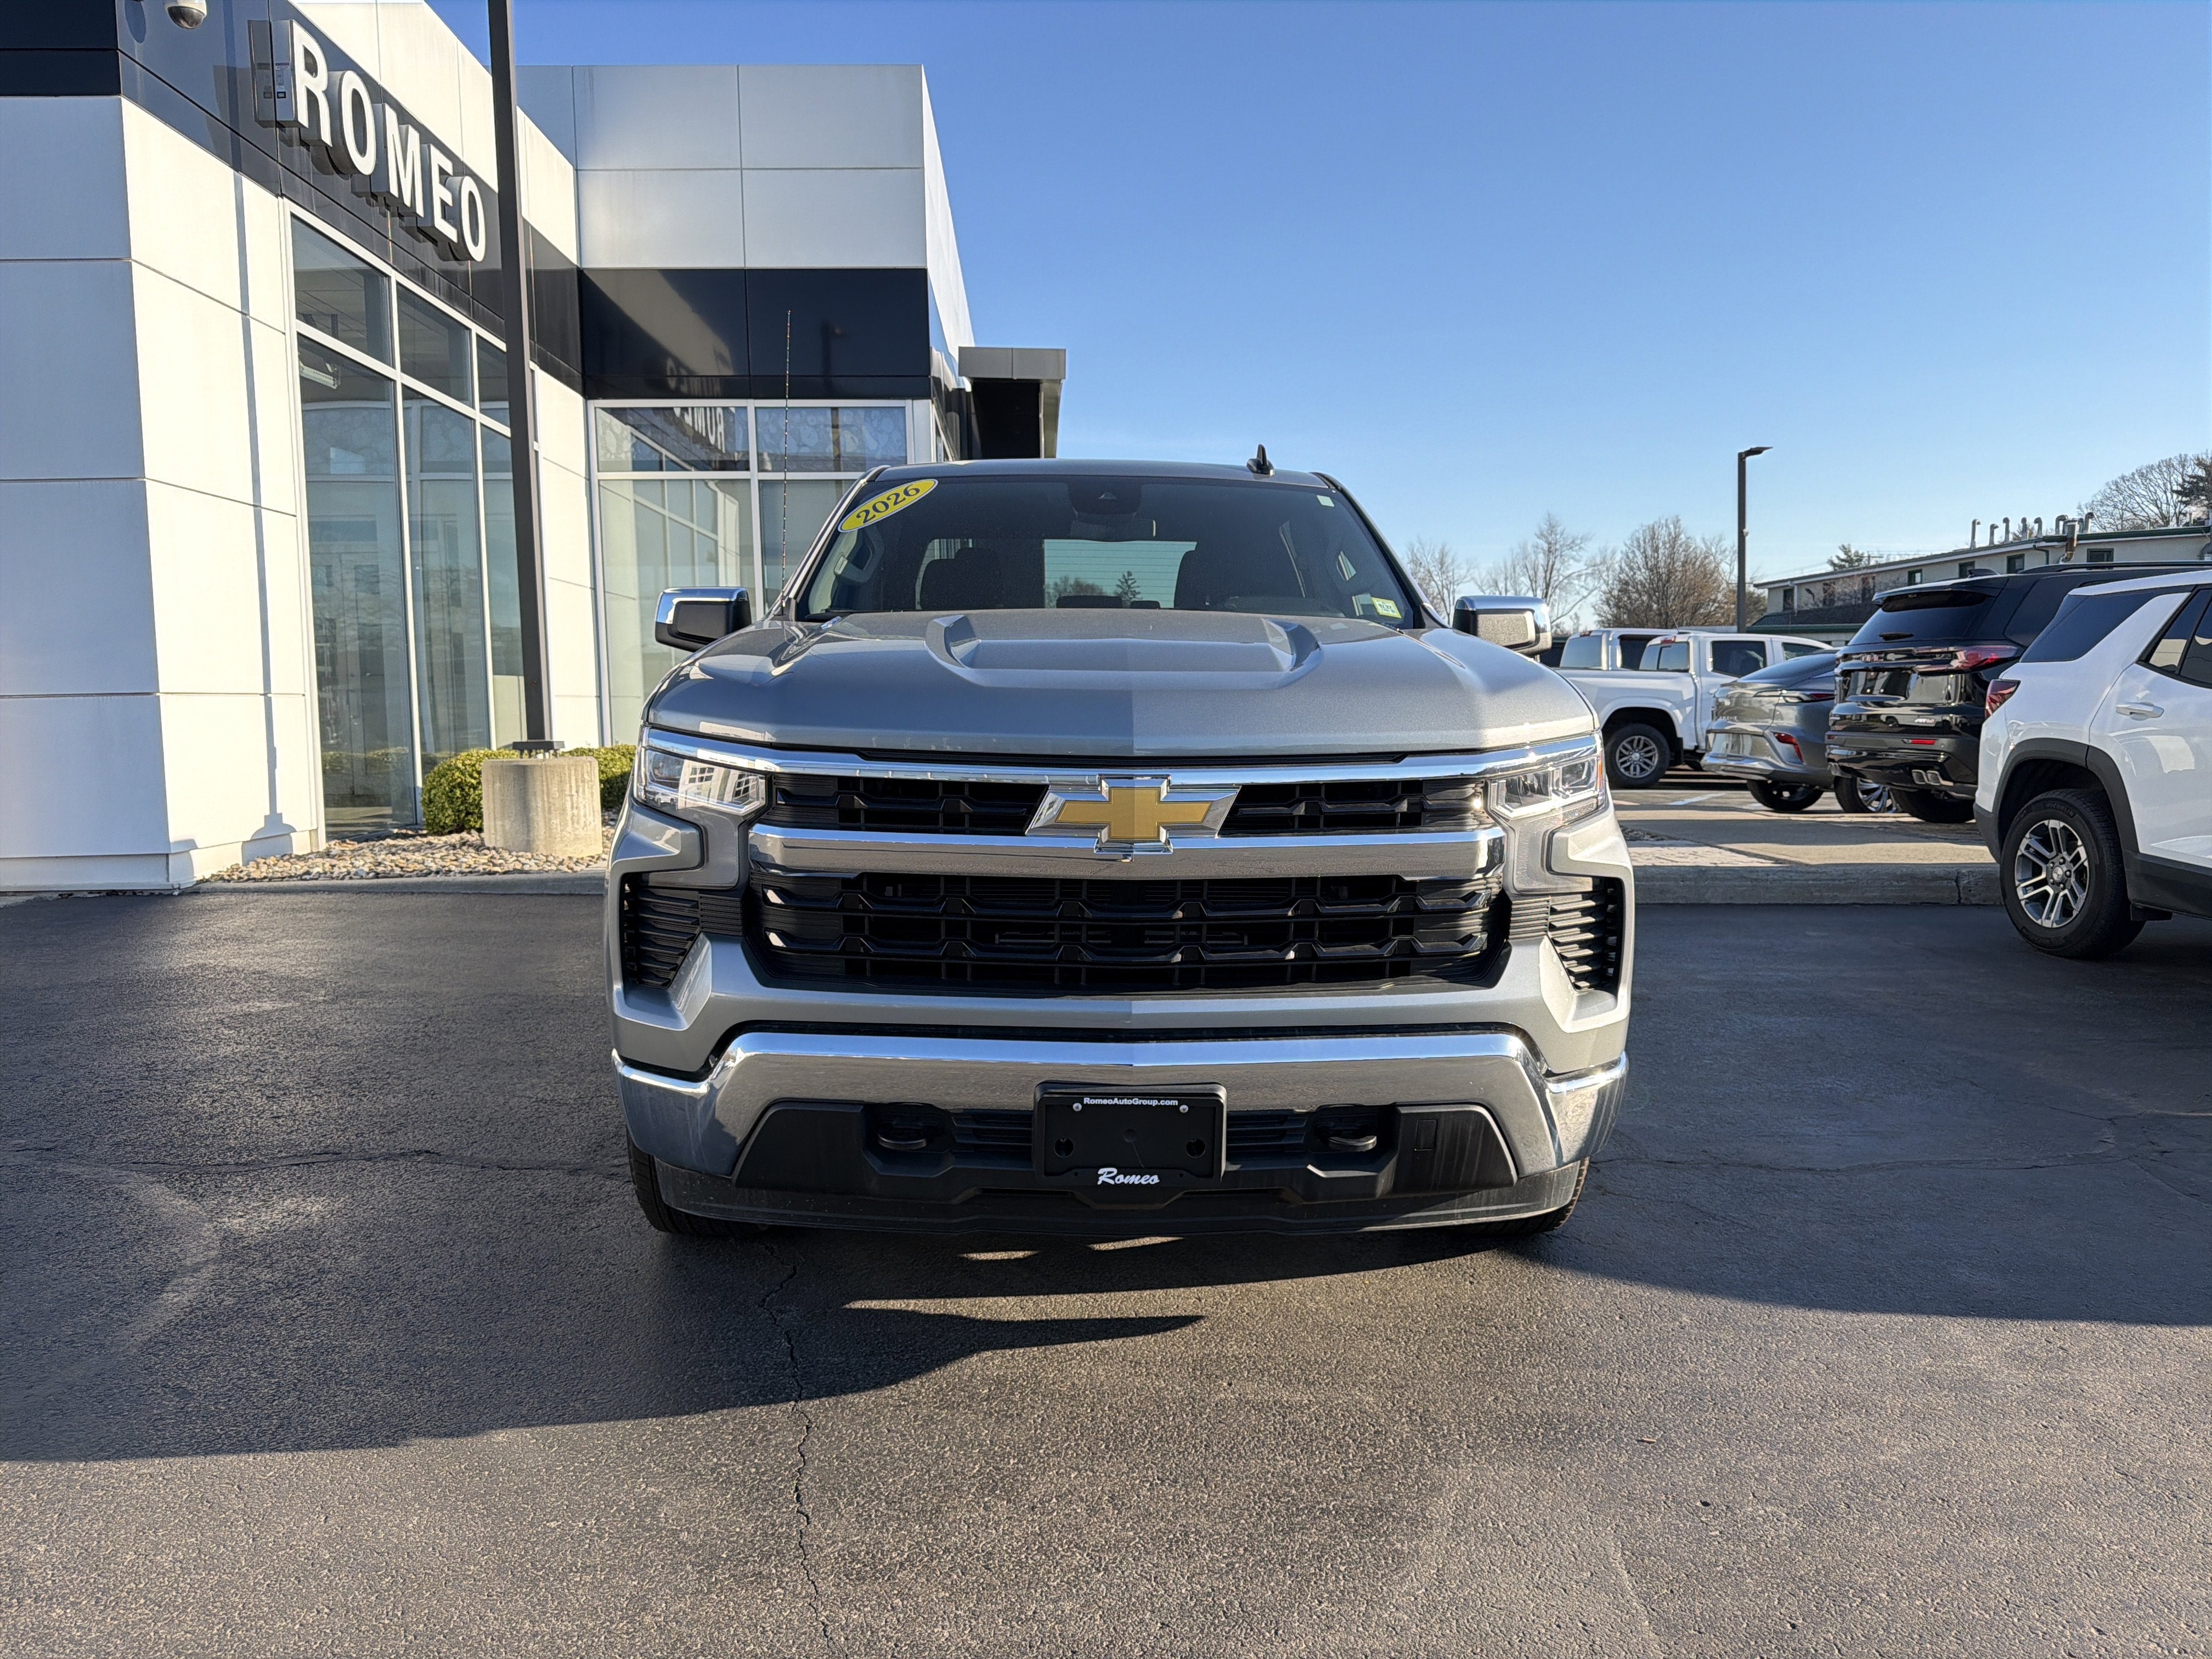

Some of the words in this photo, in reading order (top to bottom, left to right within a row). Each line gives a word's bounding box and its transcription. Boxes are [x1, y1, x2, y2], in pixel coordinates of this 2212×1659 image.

[292, 19, 486, 262] ROMEO
[856, 484, 921, 524] 2026
[1084, 1097, 1178, 1107] RomeoAutoGroup.com
[1097, 1167, 1160, 1185] Romeo
